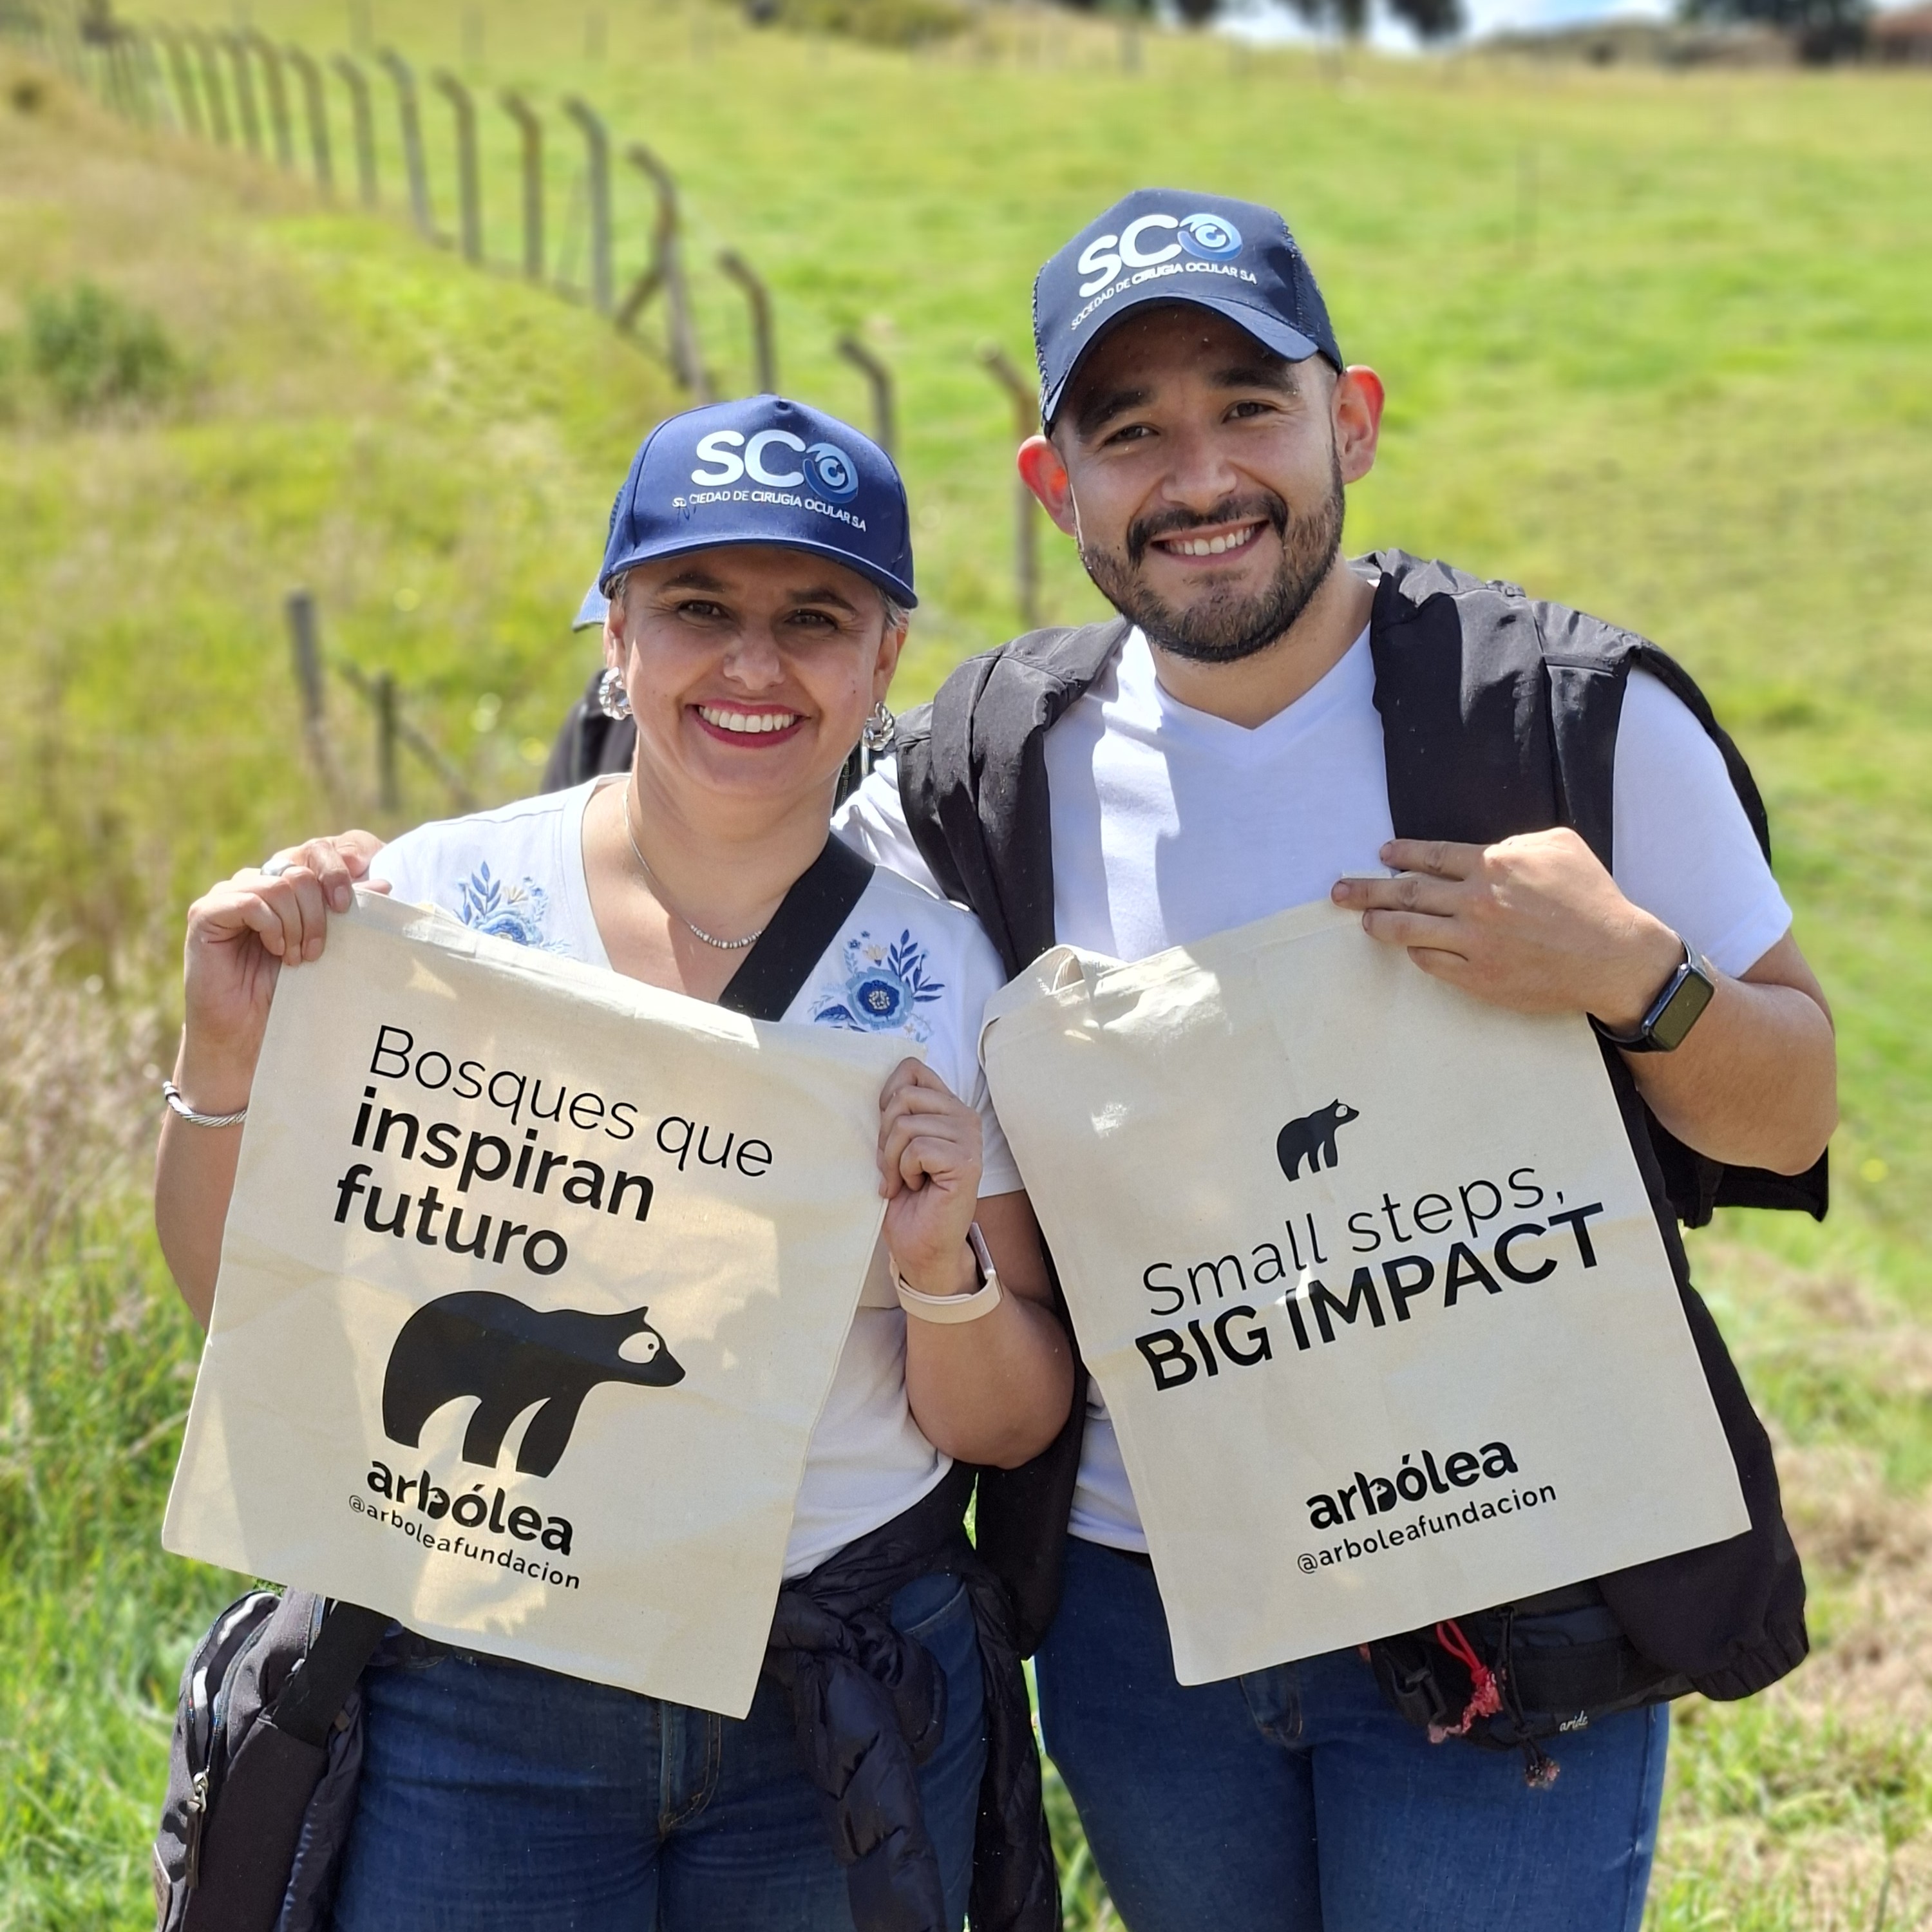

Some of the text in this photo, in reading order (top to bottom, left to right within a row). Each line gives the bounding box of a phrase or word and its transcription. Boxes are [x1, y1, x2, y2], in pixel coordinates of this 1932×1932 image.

[1070, 262, 1257, 331] SOCIEDAD DE CIRUGIA OCULAR SA
[732, 489, 750, 502] DE
[750, 489, 802, 508] CIRUGIA
[804, 498, 851, 525] OCULAR
[851, 515, 867, 533] SA
[369, 1024, 773, 1177] Bosques que
[351, 1085, 654, 1222] inspiran
[334, 1162, 569, 1276] futuro
[1142, 1167, 1565, 1316] Small steps,
[1134, 1202, 1605, 1392] BIG IMPACT
[366, 1460, 574, 1557] arbólea
[1296, 1484, 1557, 1575] @arboleafundacion
[1305, 1441, 1519, 1530] arbólea
[348, 1495, 580, 1590] @arboleafundacion
